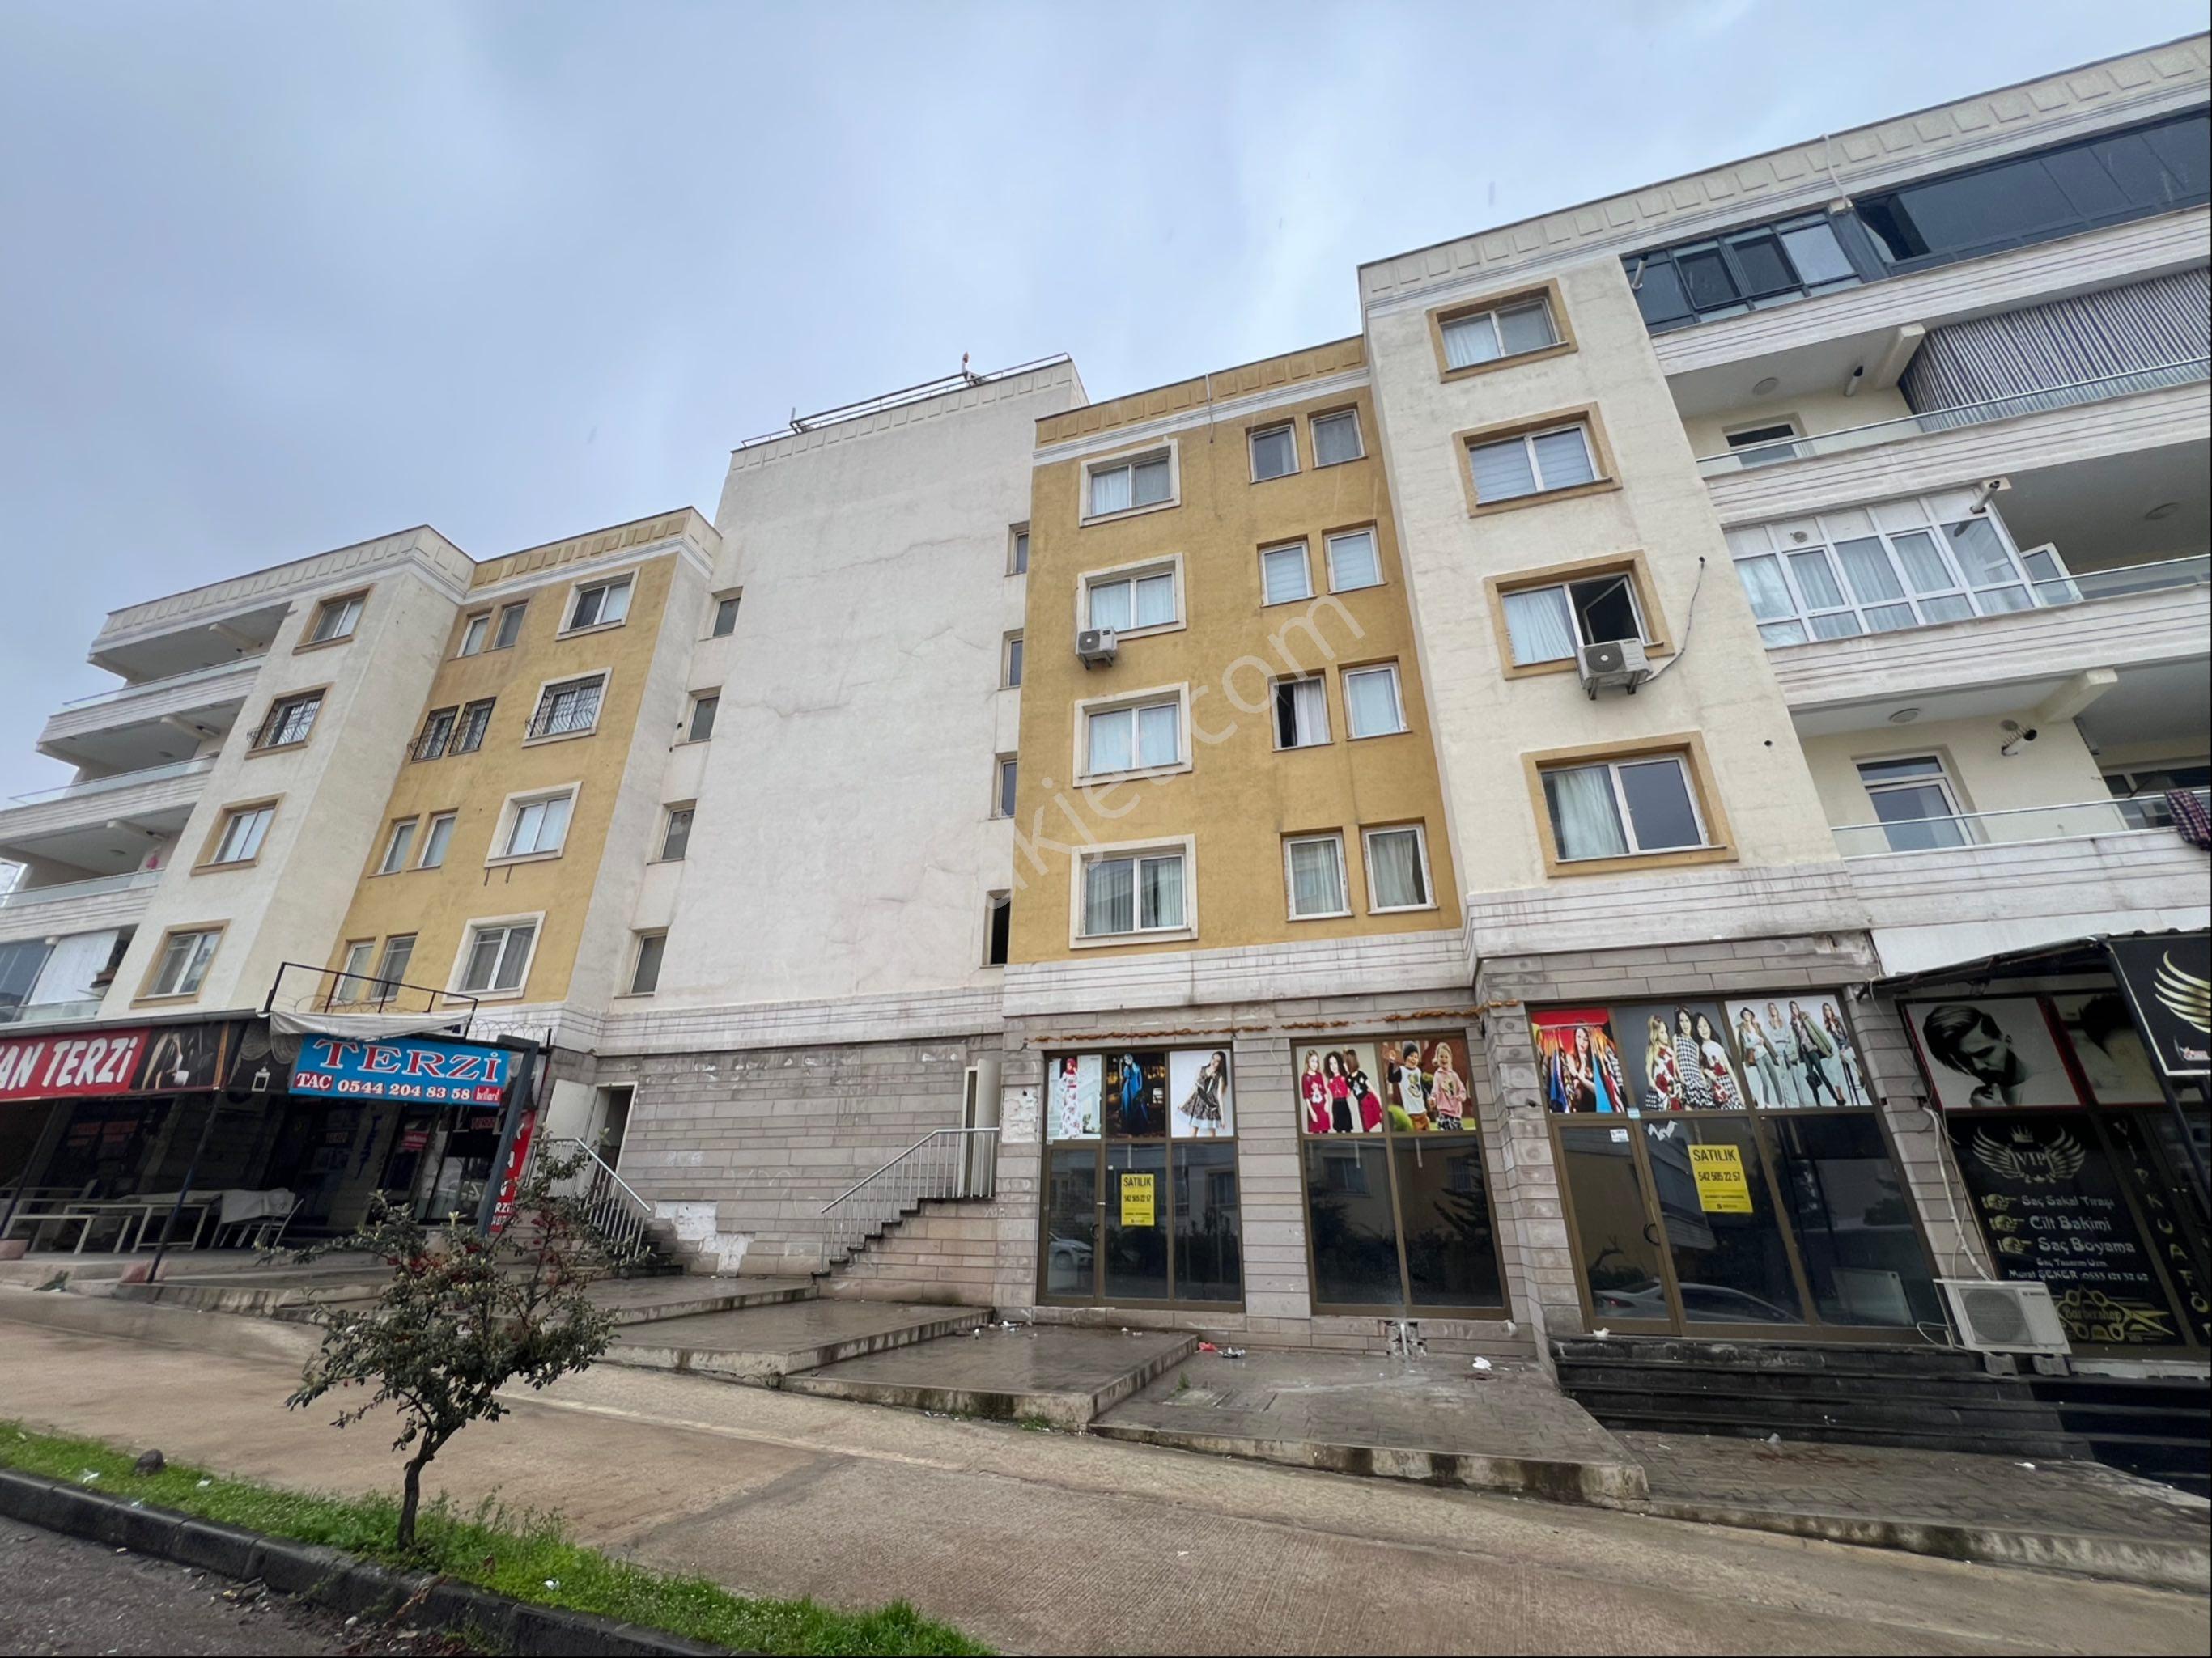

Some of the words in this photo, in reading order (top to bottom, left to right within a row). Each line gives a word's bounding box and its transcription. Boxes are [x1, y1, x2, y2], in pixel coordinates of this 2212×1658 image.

[0, 1042, 45, 1090] AN
[297, 1072, 333, 1089] TAC
[337, 1079, 384, 1095] 0544
[388, 1083, 421, 1097] 204
[426, 1085, 446, 1099] 83
[451, 1088, 471, 1100] 58
[1693, 1149, 1737, 1161] SATILIK
[2015, 1151, 2047, 1166] VIP
[1123, 1177, 1152, 1187] SATILIK
[2029, 1215, 2056, 1229] Cilt
[2038, 1237, 2070, 1254] Saç
[2070, 1237, 2136, 1255] Boyama
